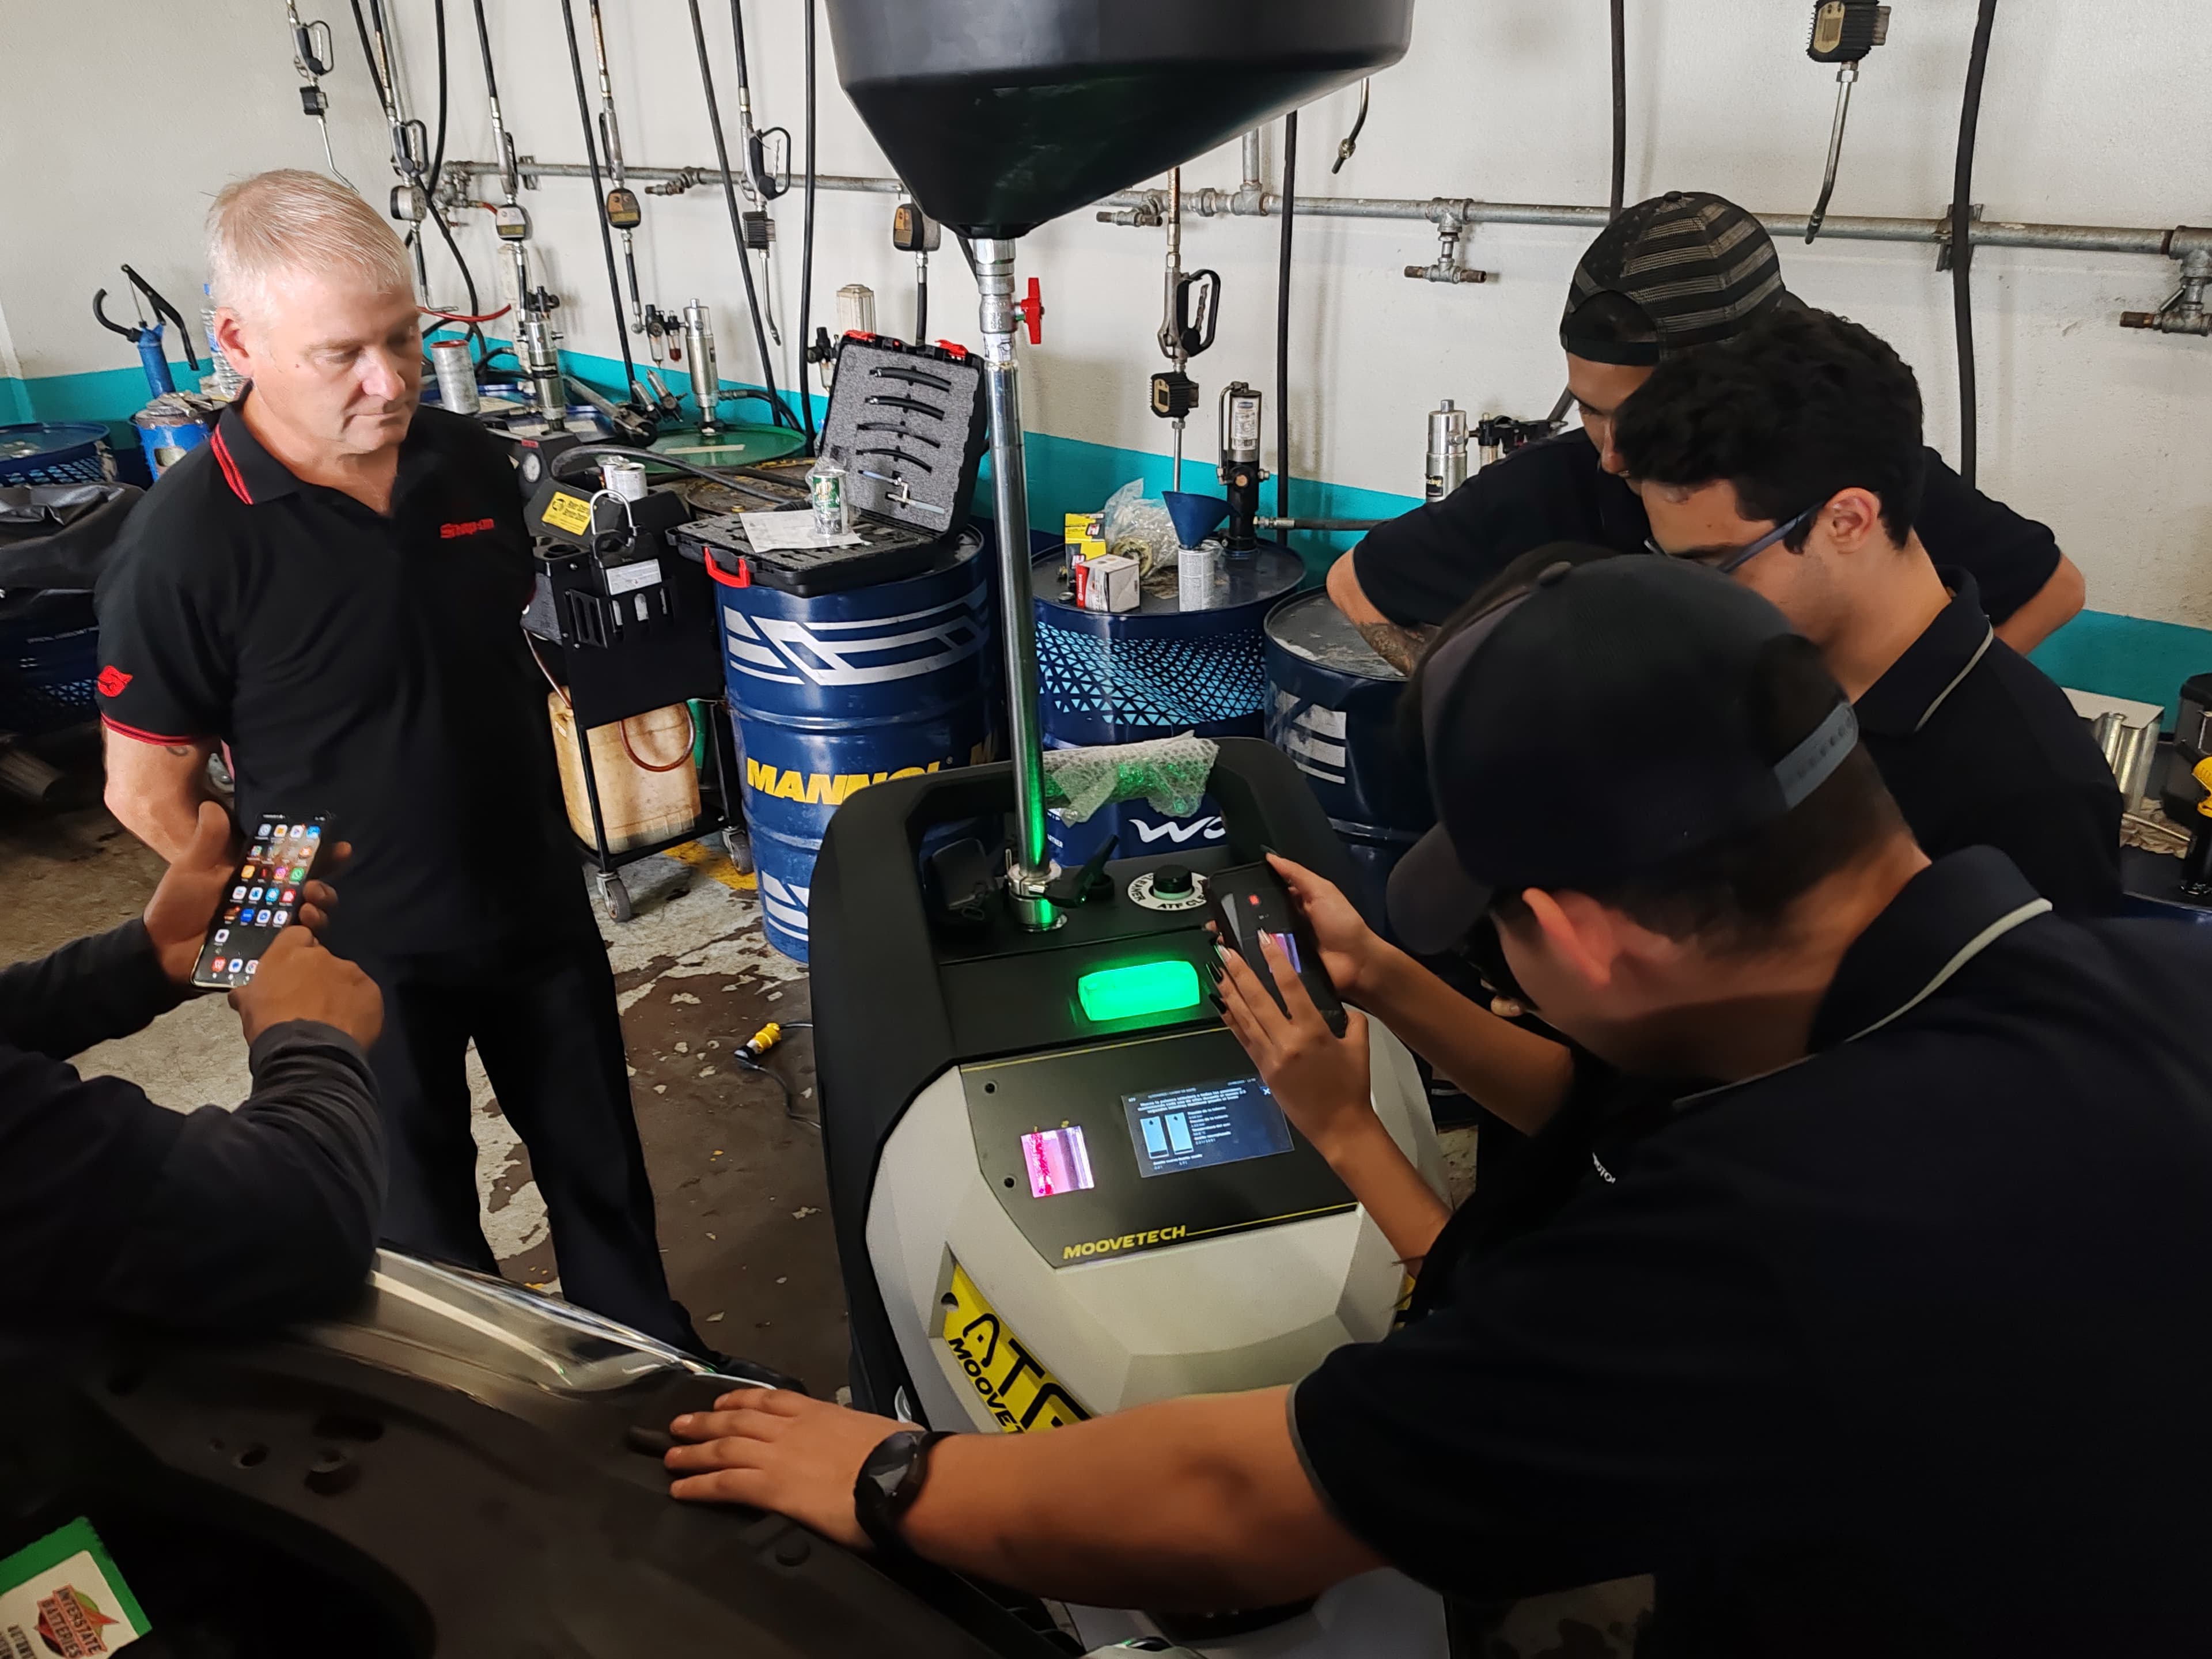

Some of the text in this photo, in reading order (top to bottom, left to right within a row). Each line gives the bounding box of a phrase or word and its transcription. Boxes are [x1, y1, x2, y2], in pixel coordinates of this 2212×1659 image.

[747, 761, 940, 805] MANN
[1063, 1225, 1185, 1259] MOOVETECH
[42, 1598, 82, 1658] BATTERIES
[56, 1586, 103, 1654] INTERSTATE
